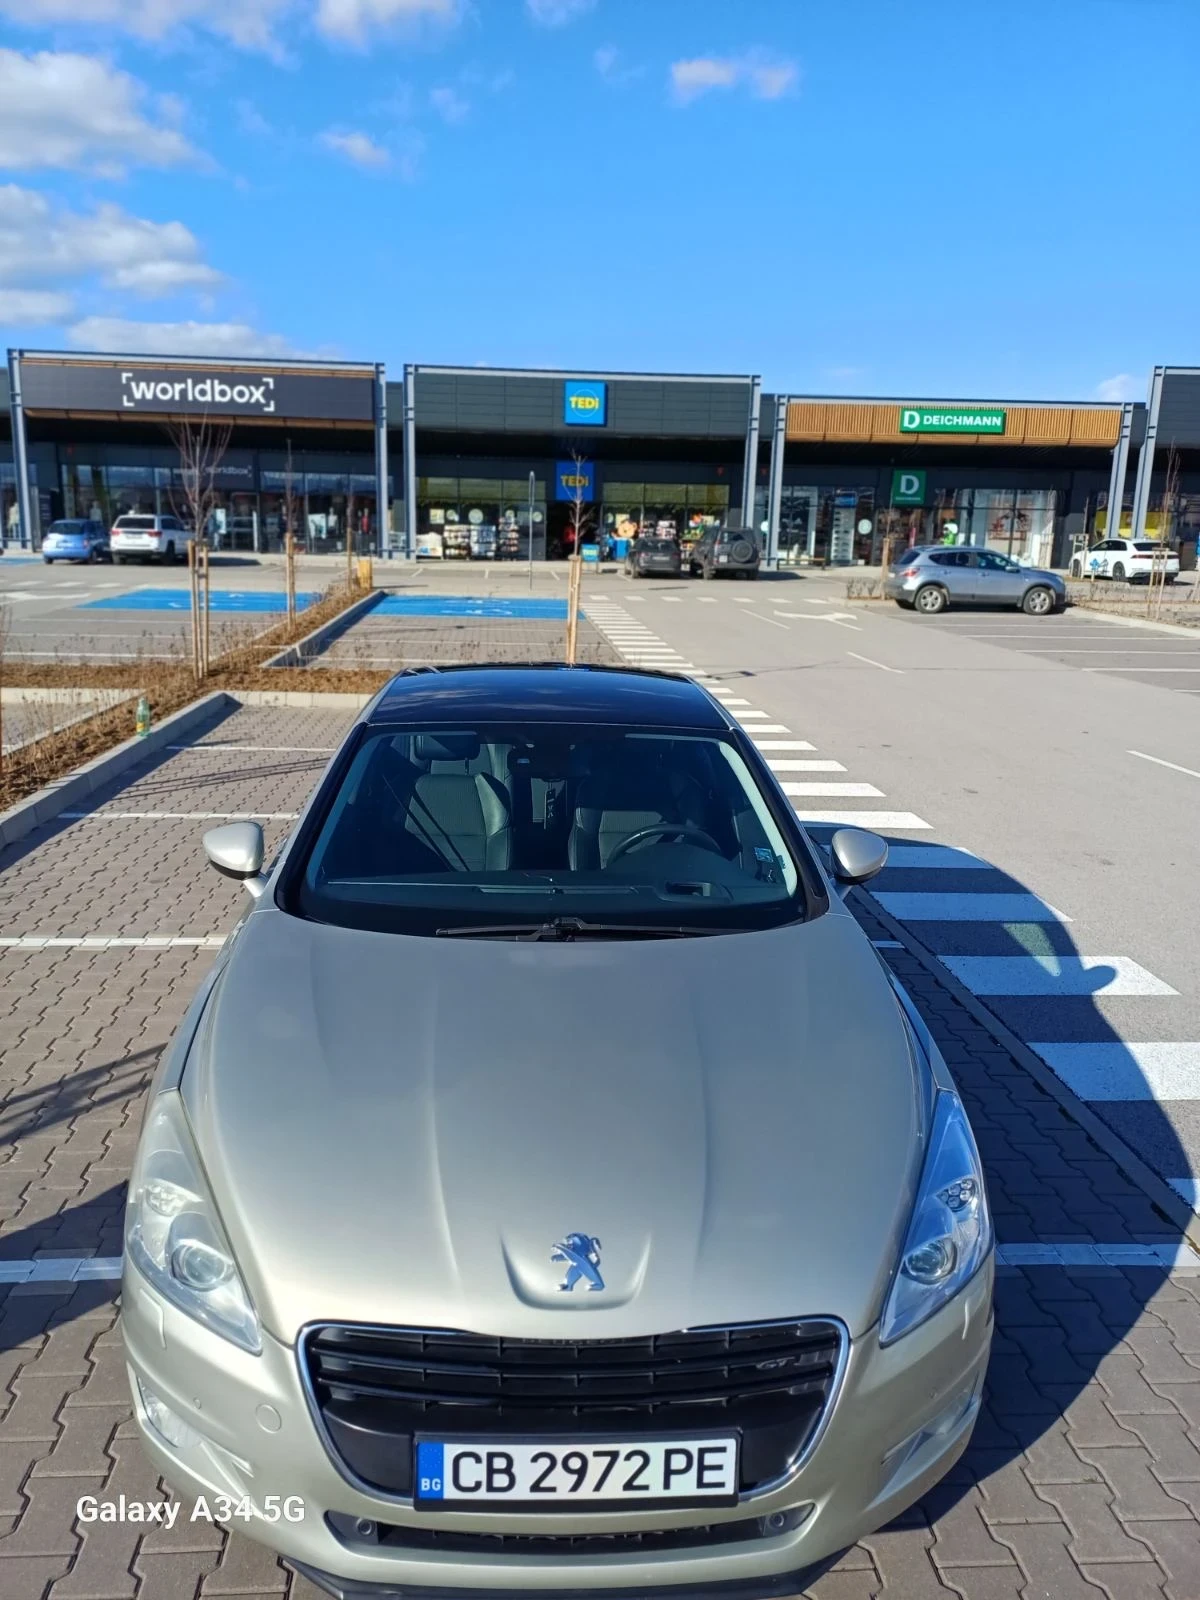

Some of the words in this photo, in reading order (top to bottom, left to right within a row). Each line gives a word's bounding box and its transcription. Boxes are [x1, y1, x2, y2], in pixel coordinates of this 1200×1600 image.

[130, 378, 266, 404] worldbox
[903, 410, 920, 429] D
[923, 415, 1002, 426] DEICHMANN
[900, 474, 920, 494] D
[451, 1450, 516, 1493] CB
[528, 1449, 651, 1493] 2972
[662, 1446, 728, 1490] PE
[420, 1478, 441, 1492] BG
